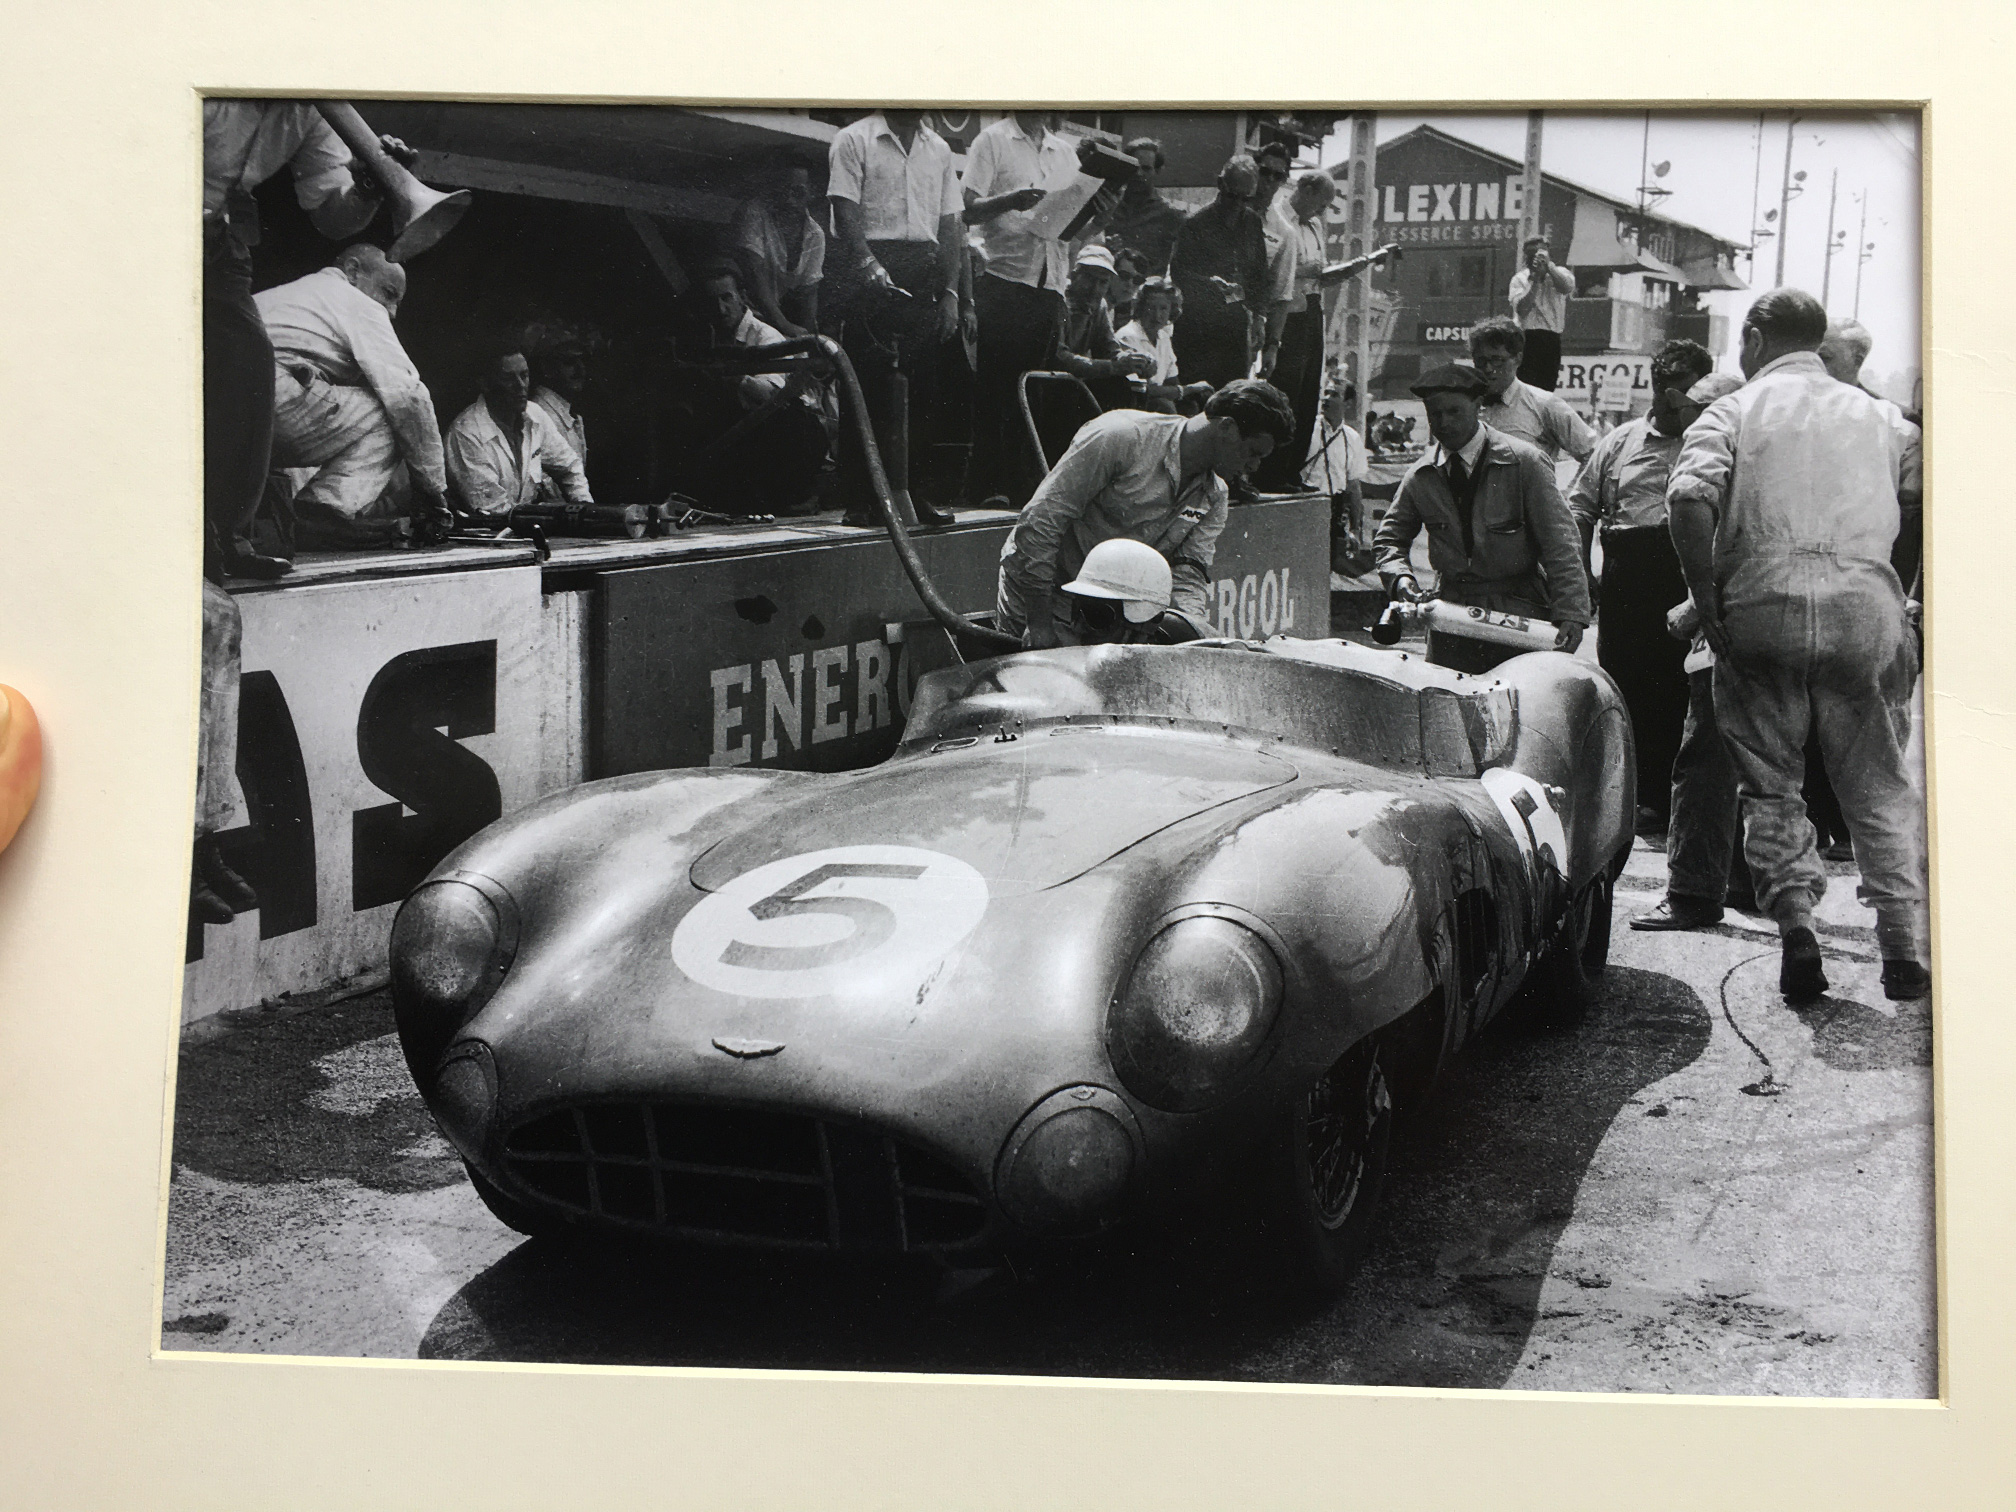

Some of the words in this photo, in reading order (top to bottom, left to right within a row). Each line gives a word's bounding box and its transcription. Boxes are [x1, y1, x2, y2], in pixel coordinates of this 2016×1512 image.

[1326, 175, 1524, 224] SLEXINE
[709, 638, 908, 767] ENER
[718, 863, 931, 972] 5
